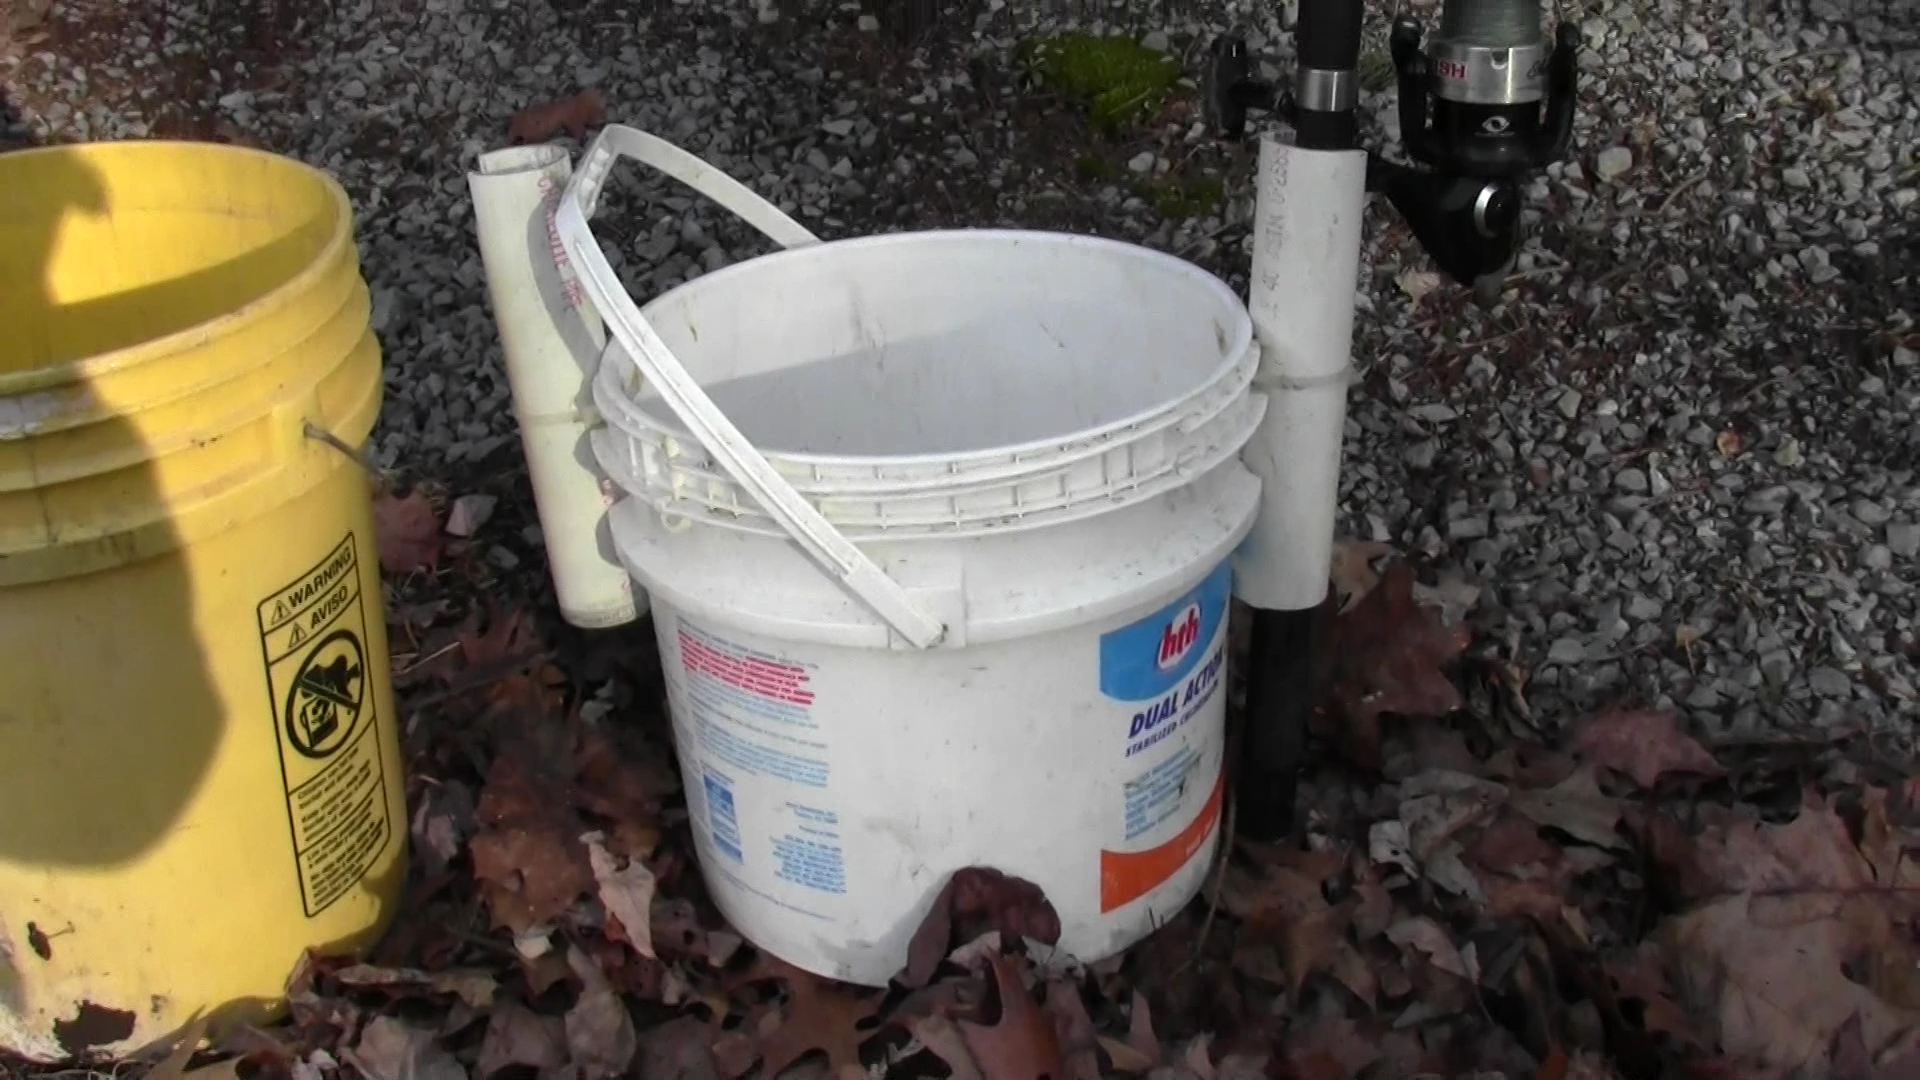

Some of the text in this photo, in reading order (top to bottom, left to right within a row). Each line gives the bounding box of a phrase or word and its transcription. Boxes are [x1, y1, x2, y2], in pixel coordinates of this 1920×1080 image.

[288, 545, 352, 608] WARNING
[310, 585, 349, 630] AVISO
[1160, 607, 1199, 663] hth
[1125, 721, 1177, 758] STABILIZED
[1128, 692, 1178, 740] DUAL
